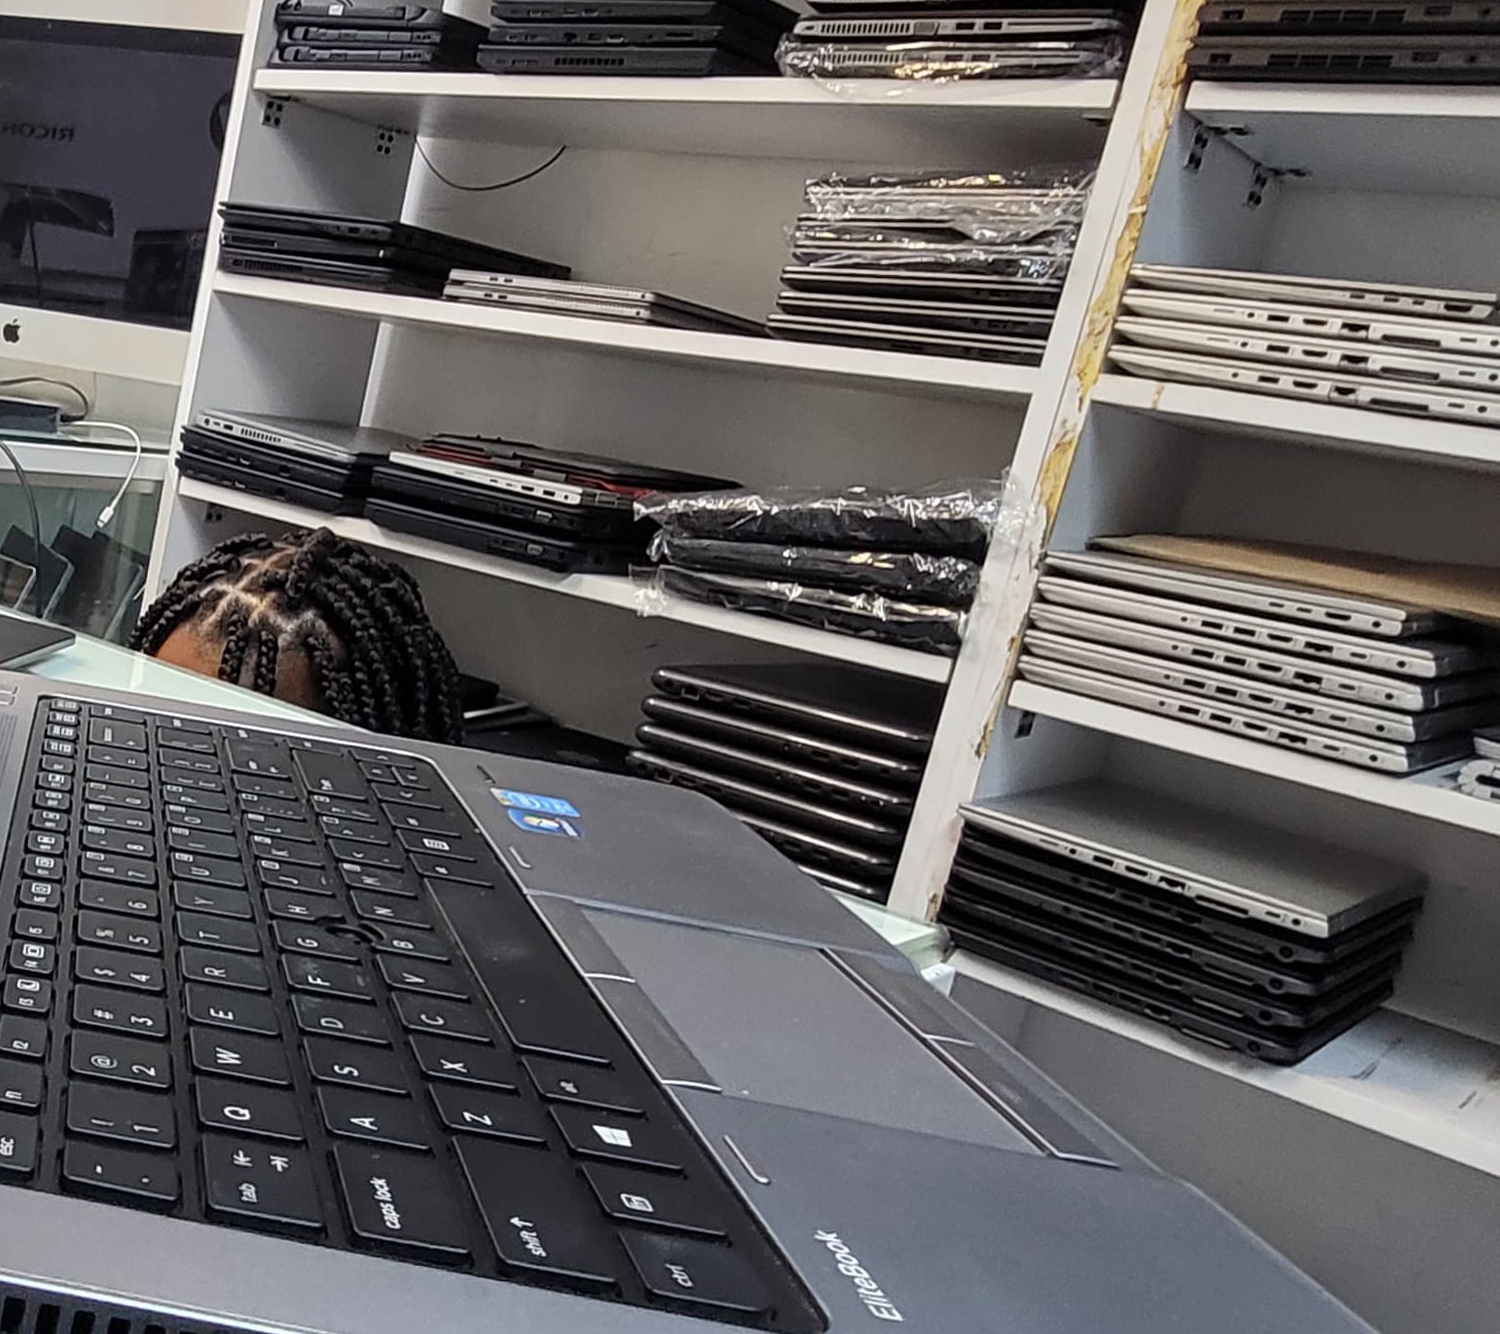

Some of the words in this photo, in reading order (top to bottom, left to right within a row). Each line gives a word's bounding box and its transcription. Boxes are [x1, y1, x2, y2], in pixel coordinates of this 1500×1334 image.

[210, 1007, 234, 1020] E
[420, 1013, 445, 1026] C
[320, 1017, 344, 1029] D
[215, 1047, 242, 1065] W
[131, 1064, 156, 1077] 2
[333, 1064, 359, 1077] S
[440, 1058, 468, 1073] X
[224, 1106, 251, 1121] Q
[462, 1111, 492, 1126] Z
[350, 1117, 378, 1131] A
[0, 1136, 15, 1156] esc
[238, 1182, 258, 1203] tab
[370, 1177, 392, 1202] lock
[380, 1202, 401, 1230] caps
[519, 1230, 547, 1257] shift
[665, 1263, 693, 1288] ctrl
[813, 1229, 904, 1322] EliteBook
